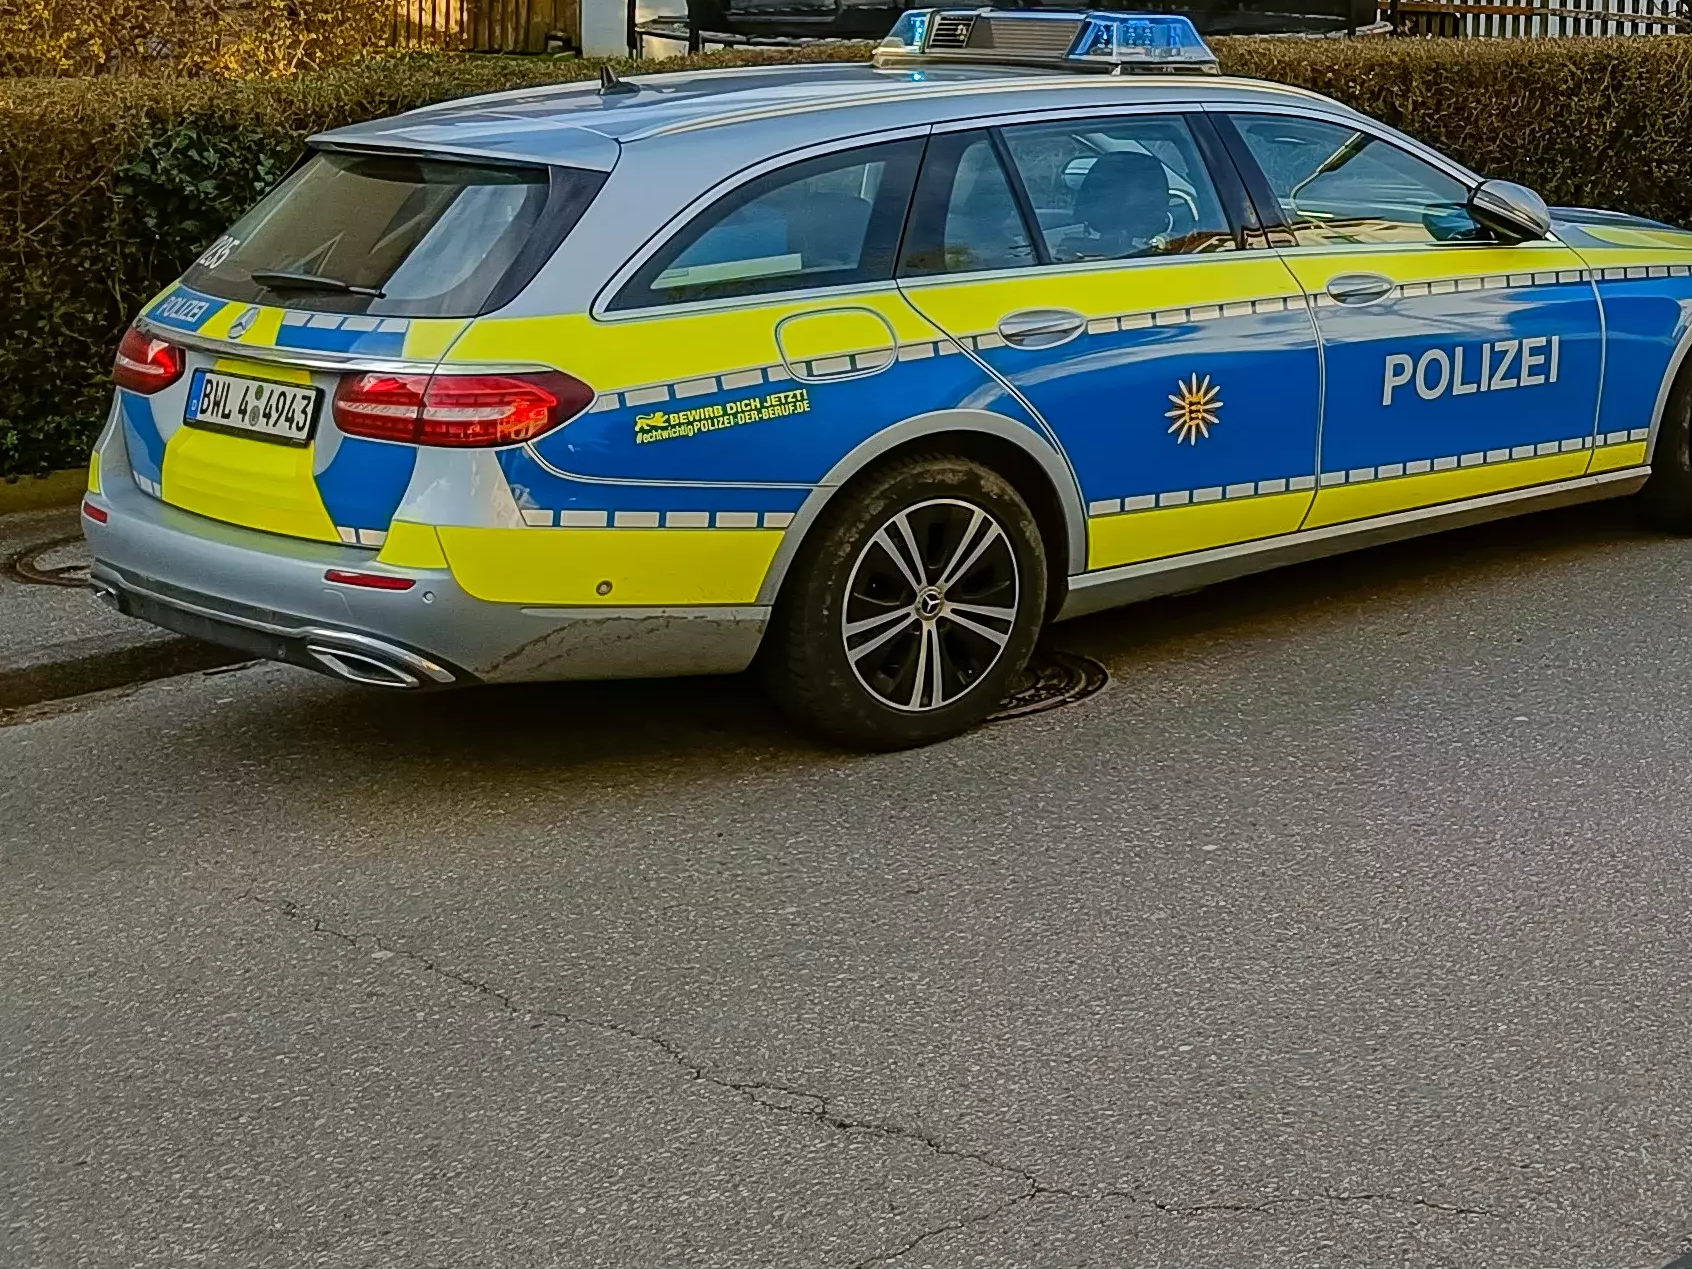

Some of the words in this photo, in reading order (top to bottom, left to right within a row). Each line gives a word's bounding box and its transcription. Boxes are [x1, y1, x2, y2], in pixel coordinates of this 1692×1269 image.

[156, 296, 210, 322] POLIZEI
[1382, 335, 1560, 406] POLIZEI
[199, 378, 232, 420] BWL
[238, 385, 250, 423] 4
[262, 389, 312, 432] 4943
[669, 405, 723, 425] BEWIRB
[726, 397, 761, 415] DICH
[763, 388, 808, 407] JETZT!
